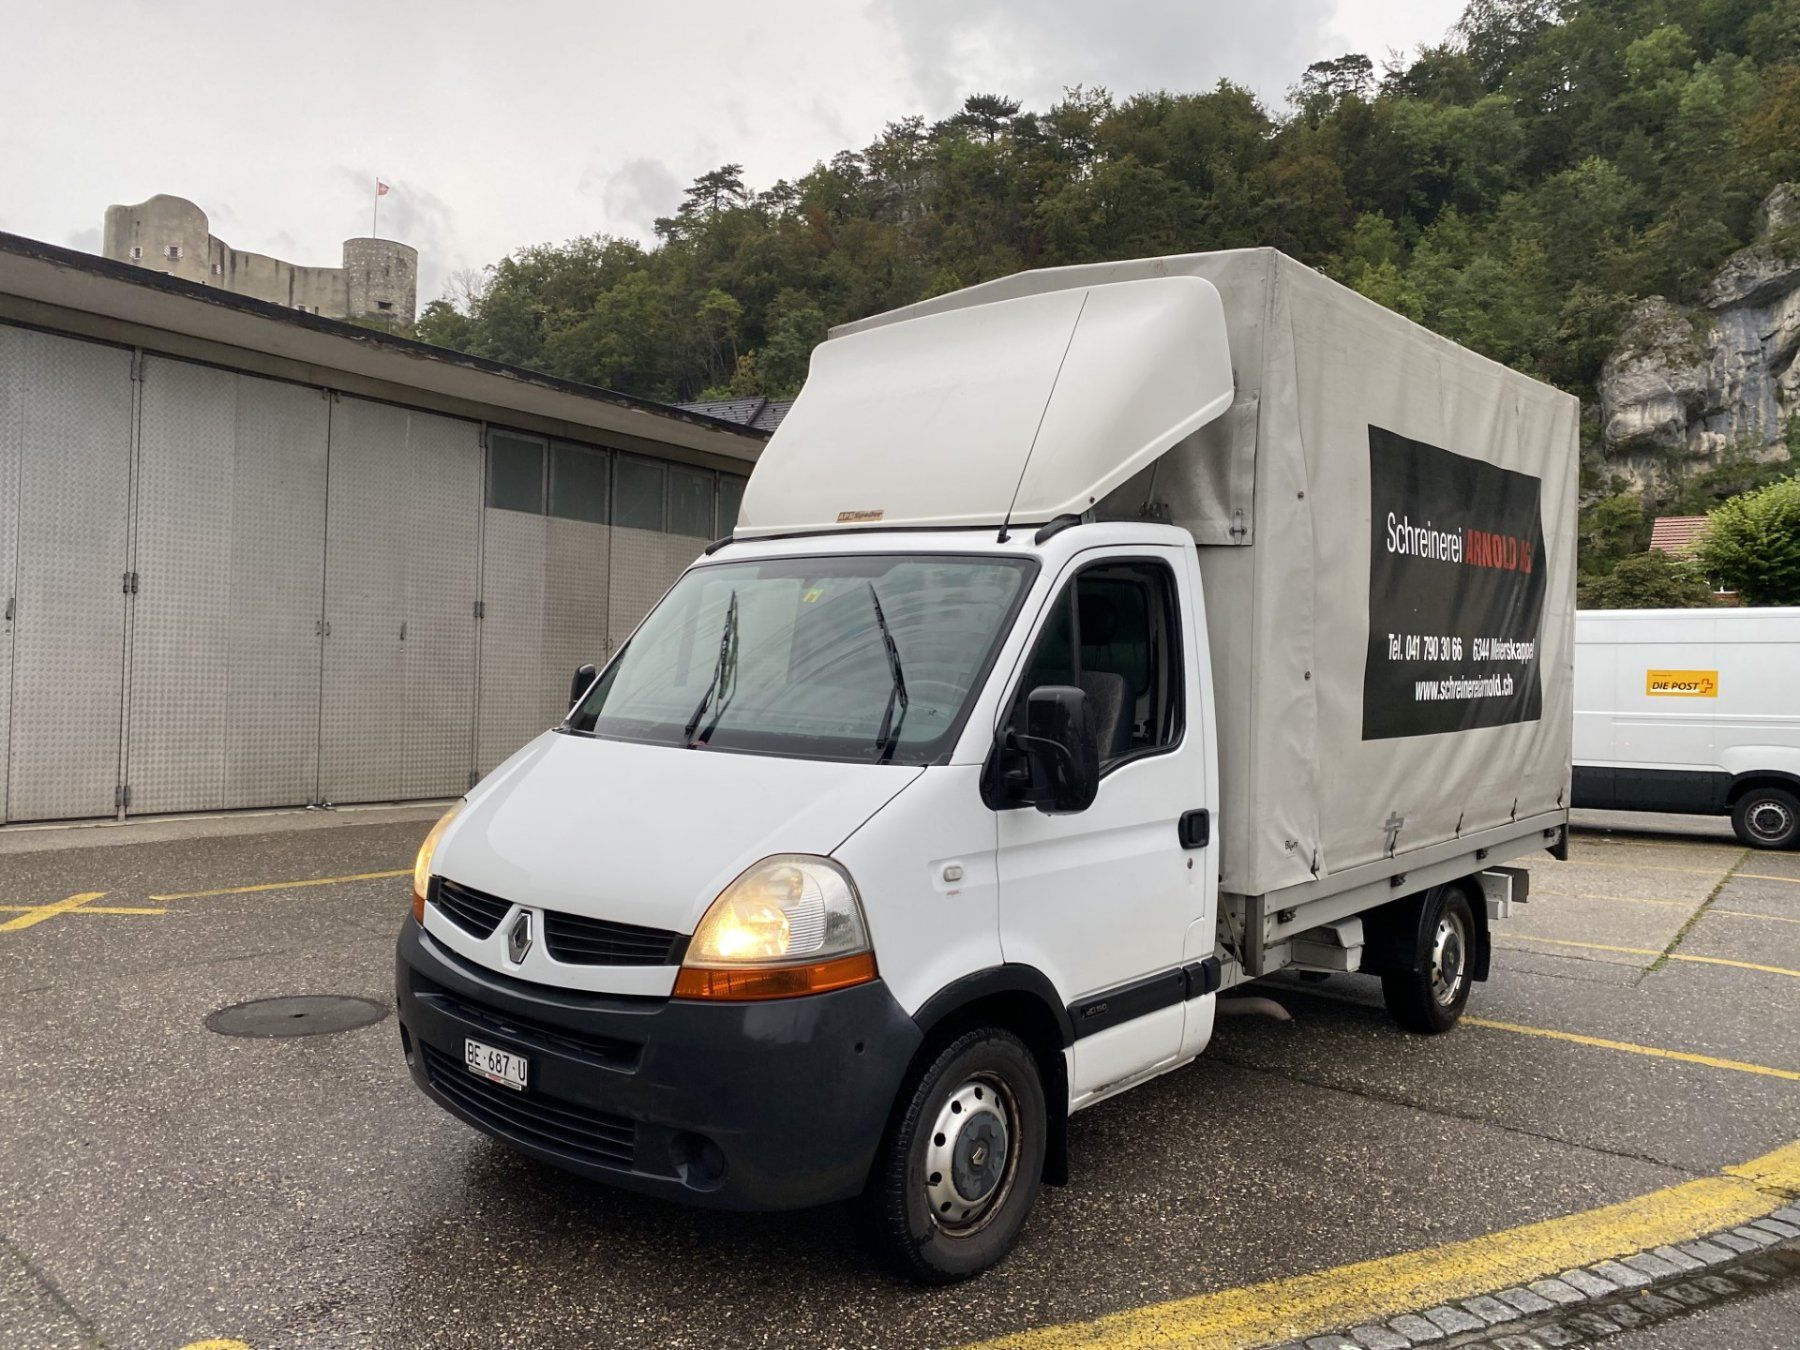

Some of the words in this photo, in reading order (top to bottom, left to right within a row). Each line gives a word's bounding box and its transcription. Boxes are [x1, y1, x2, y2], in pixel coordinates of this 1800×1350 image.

[1387, 511, 1463, 563] Schreinerei
[1466, 528, 1517, 571] ARNOLD
[1388, 633, 1403, 660] Tel.
[1405, 634, 1421, 661] 041
[1423, 635, 1439, 661] 790
[1440, 636, 1451, 661] 30
[1452, 636, 1463, 661] 66
[1472, 637, 1490, 661] 6344
[1652, 681, 1669, 690] DIE
[1671, 682, 1700, 691] POST
